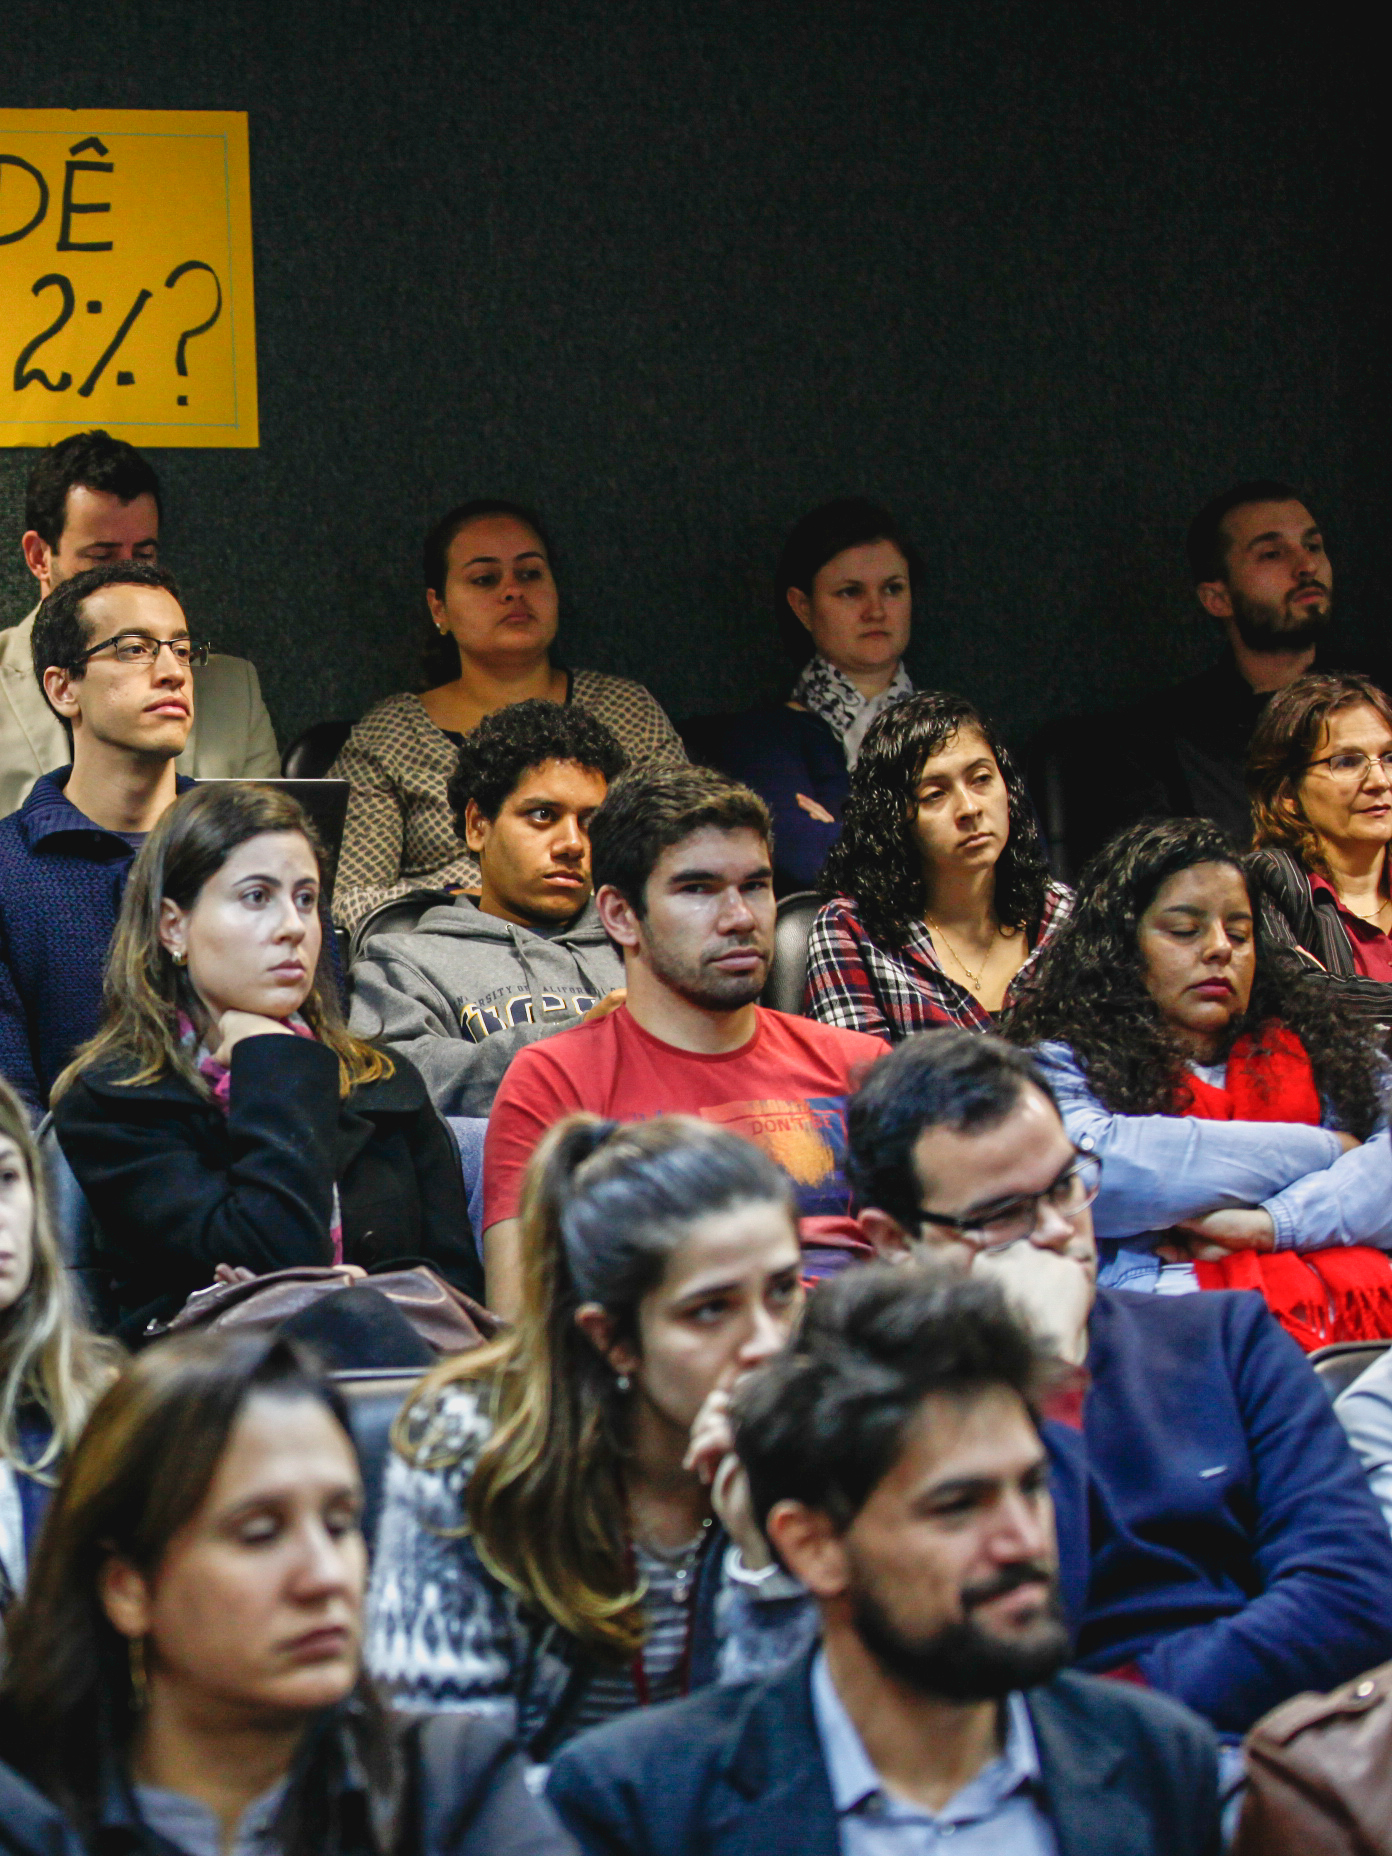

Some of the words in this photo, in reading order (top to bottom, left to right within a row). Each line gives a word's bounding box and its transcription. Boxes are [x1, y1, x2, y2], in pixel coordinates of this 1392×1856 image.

[13, 260, 223, 407] 2%?
[752, 1117, 805, 1136] DON'T
[811, 1114, 833, 1130] BE
